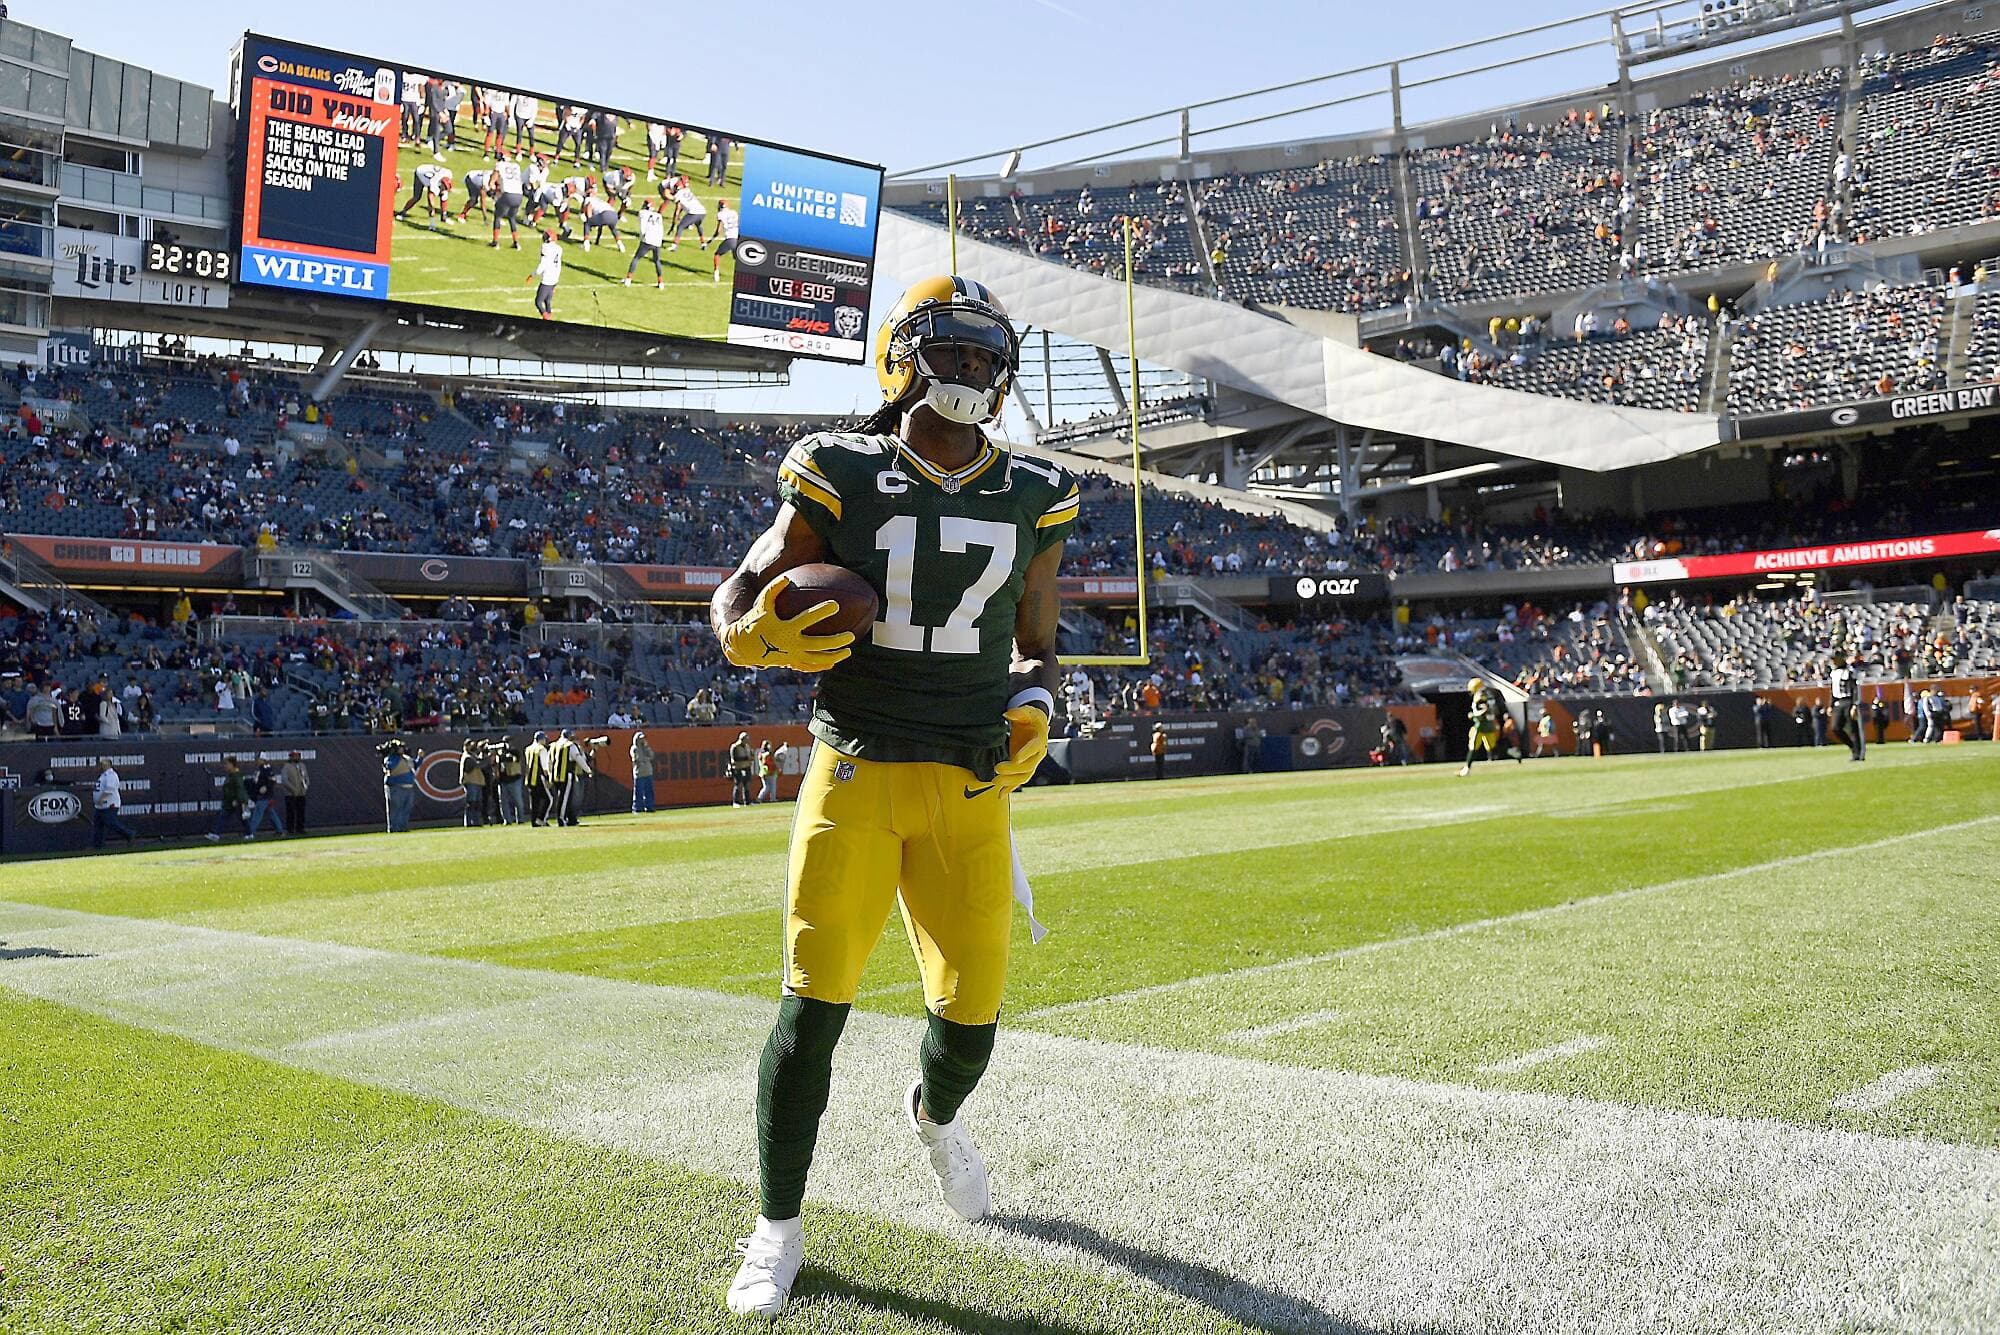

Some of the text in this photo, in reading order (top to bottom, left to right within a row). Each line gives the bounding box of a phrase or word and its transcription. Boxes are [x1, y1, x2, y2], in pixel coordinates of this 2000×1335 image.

[279, 61, 331, 82] DA BEARS
[271, 88, 371, 120] DID YOU
[268, 120, 365, 151] THE BEARS LEAD
[331, 111, 391, 136] KNOW
[267, 136, 366, 168] THE NFL WITH 18
[265, 154, 348, 181] SACKS ON THE
[265, 169, 312, 192] SEASON
[771, 181, 837, 205] UNITED
[752, 193, 836, 220] AIRLINES
[74, 253, 137, 289] Lite
[151, 243, 230, 279] 32:03
[252, 253, 376, 291] WIPFLI
[775, 252, 828, 274] GREEN
[162, 282, 210, 305] LOFT
[769, 277, 835, 303] VERSUS
[735, 299, 820, 322] CHICAGO
[52, 342, 90, 366] Lite
[1891, 386, 1994, 419] GREEN BAY
[876, 470, 908, 494] C
[141, 547, 201, 566] BEARS
[1754, 539, 1935, 571] ACHIEVE AMBITIONS
[294, 563, 311, 574] 122
[570, 574, 584, 585] 123
[872, 515, 1017, 654] 17
[1319, 578, 1360, 595] razr
[68, 706, 81, 720] 52
[40, 797, 69, 810] FOX
